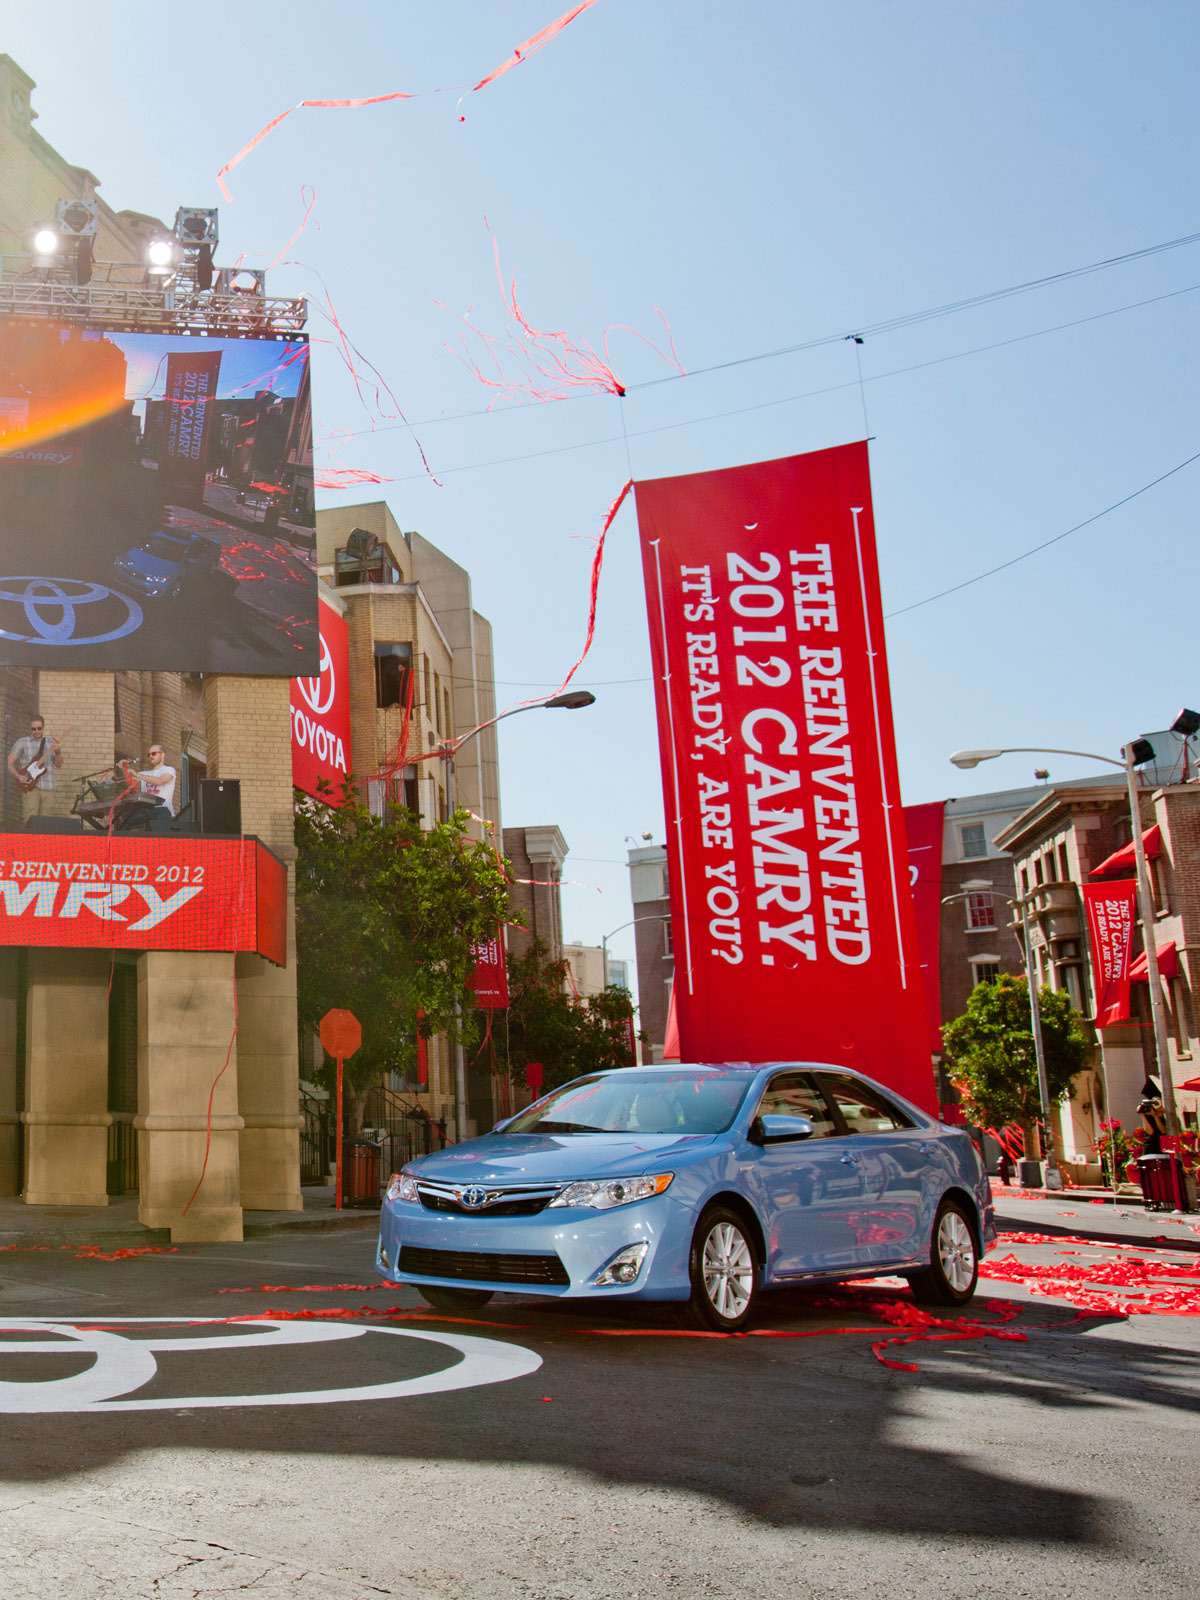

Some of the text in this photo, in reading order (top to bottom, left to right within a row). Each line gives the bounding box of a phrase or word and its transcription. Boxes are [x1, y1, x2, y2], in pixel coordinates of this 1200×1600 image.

[198, 373, 208, 393] THE
[680, 564, 744, 965] IT'S READY, ARE YOU?
[726, 552, 817, 966] 2012 CAMRY.
[789, 544, 872, 966] THE REINVENTED
[10, 862, 149, 882] REINVENTED
[155, 866, 204, 883] 2012
[1105, 900, 1122, 929] 2012
[1119, 900, 1130, 919] THE
[1102, 945, 1111, 960] ARE
